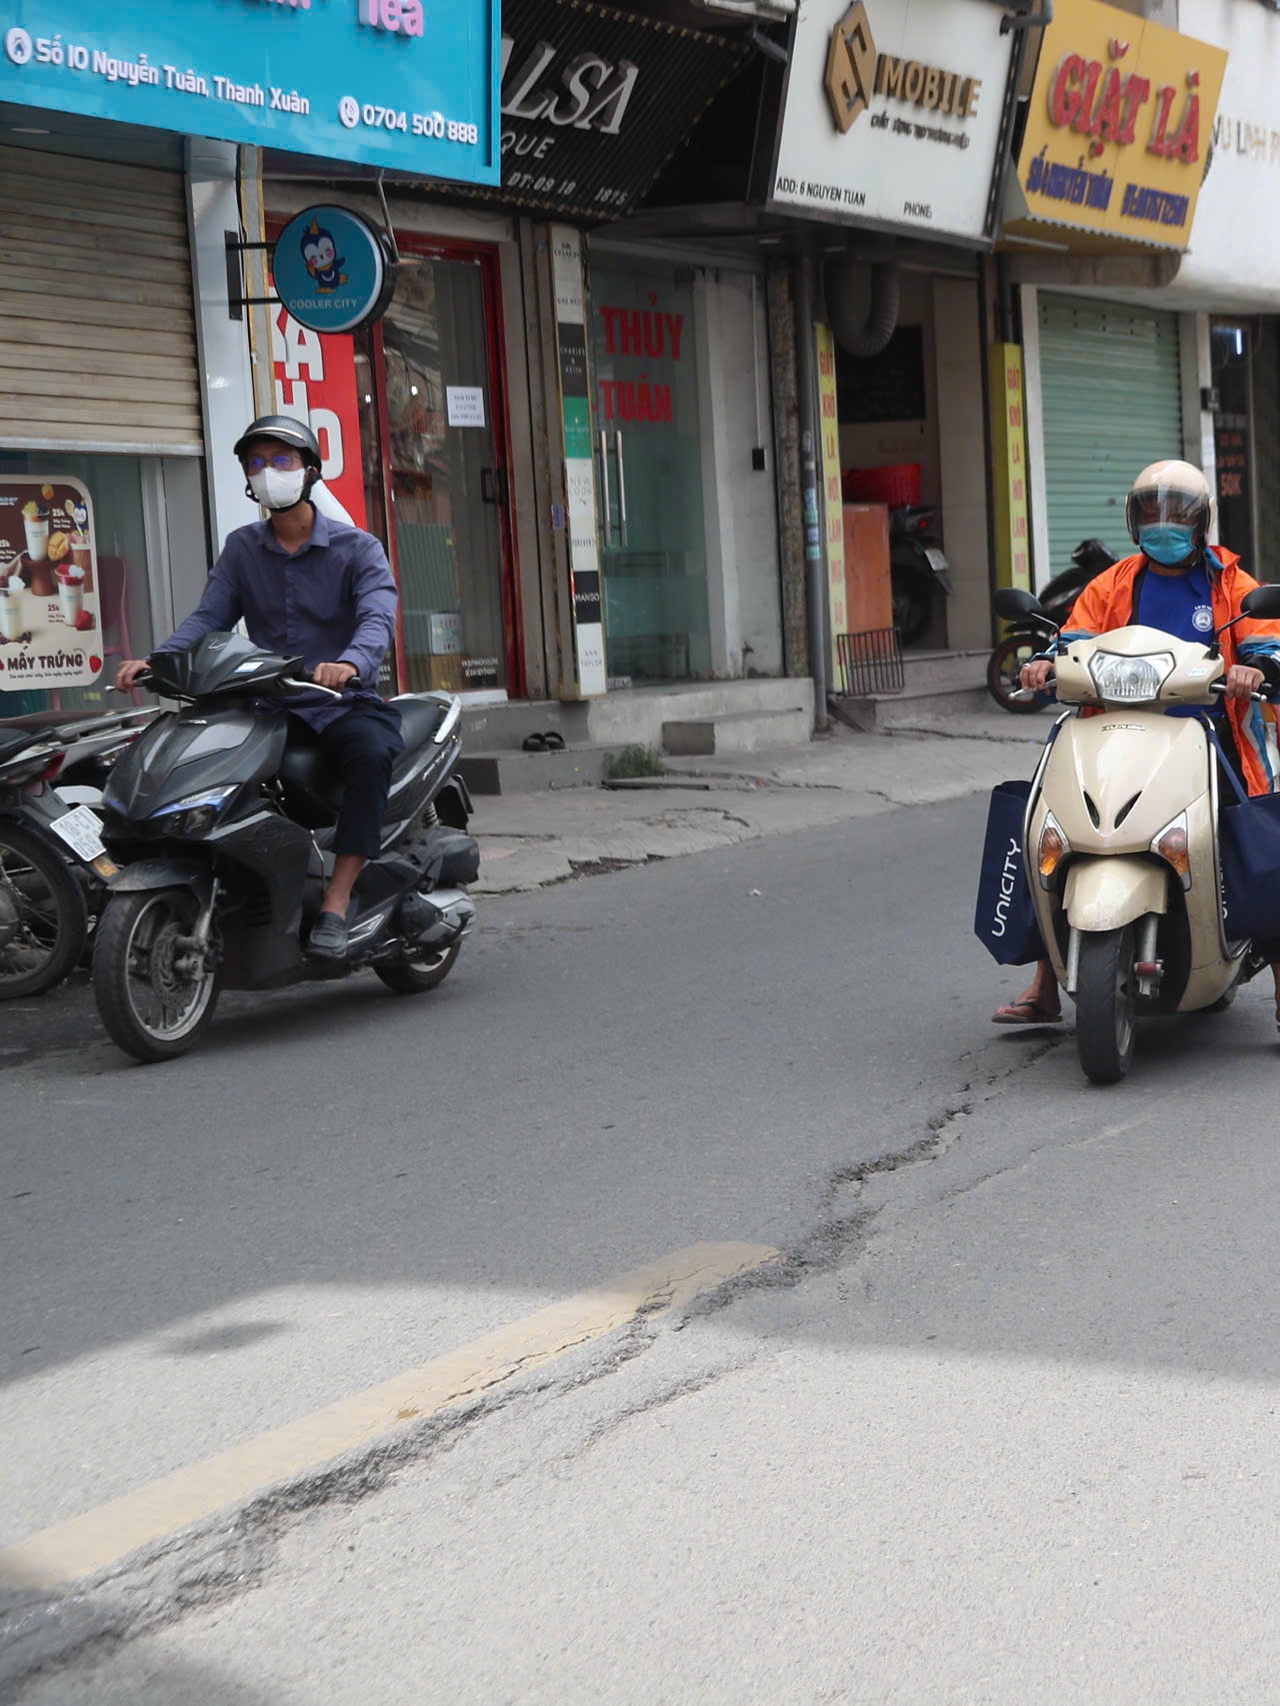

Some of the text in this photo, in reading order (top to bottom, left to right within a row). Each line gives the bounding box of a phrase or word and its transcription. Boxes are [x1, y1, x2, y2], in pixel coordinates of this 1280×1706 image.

[36, 35, 64, 64] Số
[92, 53, 159, 87] Nguyễn
[213, 75, 265, 107] Thanh
[269, 86, 310, 115] Xuân
[876, 53, 982, 117] MOBILE
[1048, 37, 1150, 158] GIẶT
[362, 104, 478, 145] 0704 500 888
[776, 177, 799, 195] ADD:
[806, 183, 842, 201] NGUYEN
[843, 189, 866, 207] TUAN
[289, 298, 357, 310] COOLER CITY
[598, 290, 685, 361] THỦY
[575, 592, 600, 602] MANGO
[7, 645, 84, 671] MẤY TRỨNG
[991, 837, 1022, 938] UNICITY
